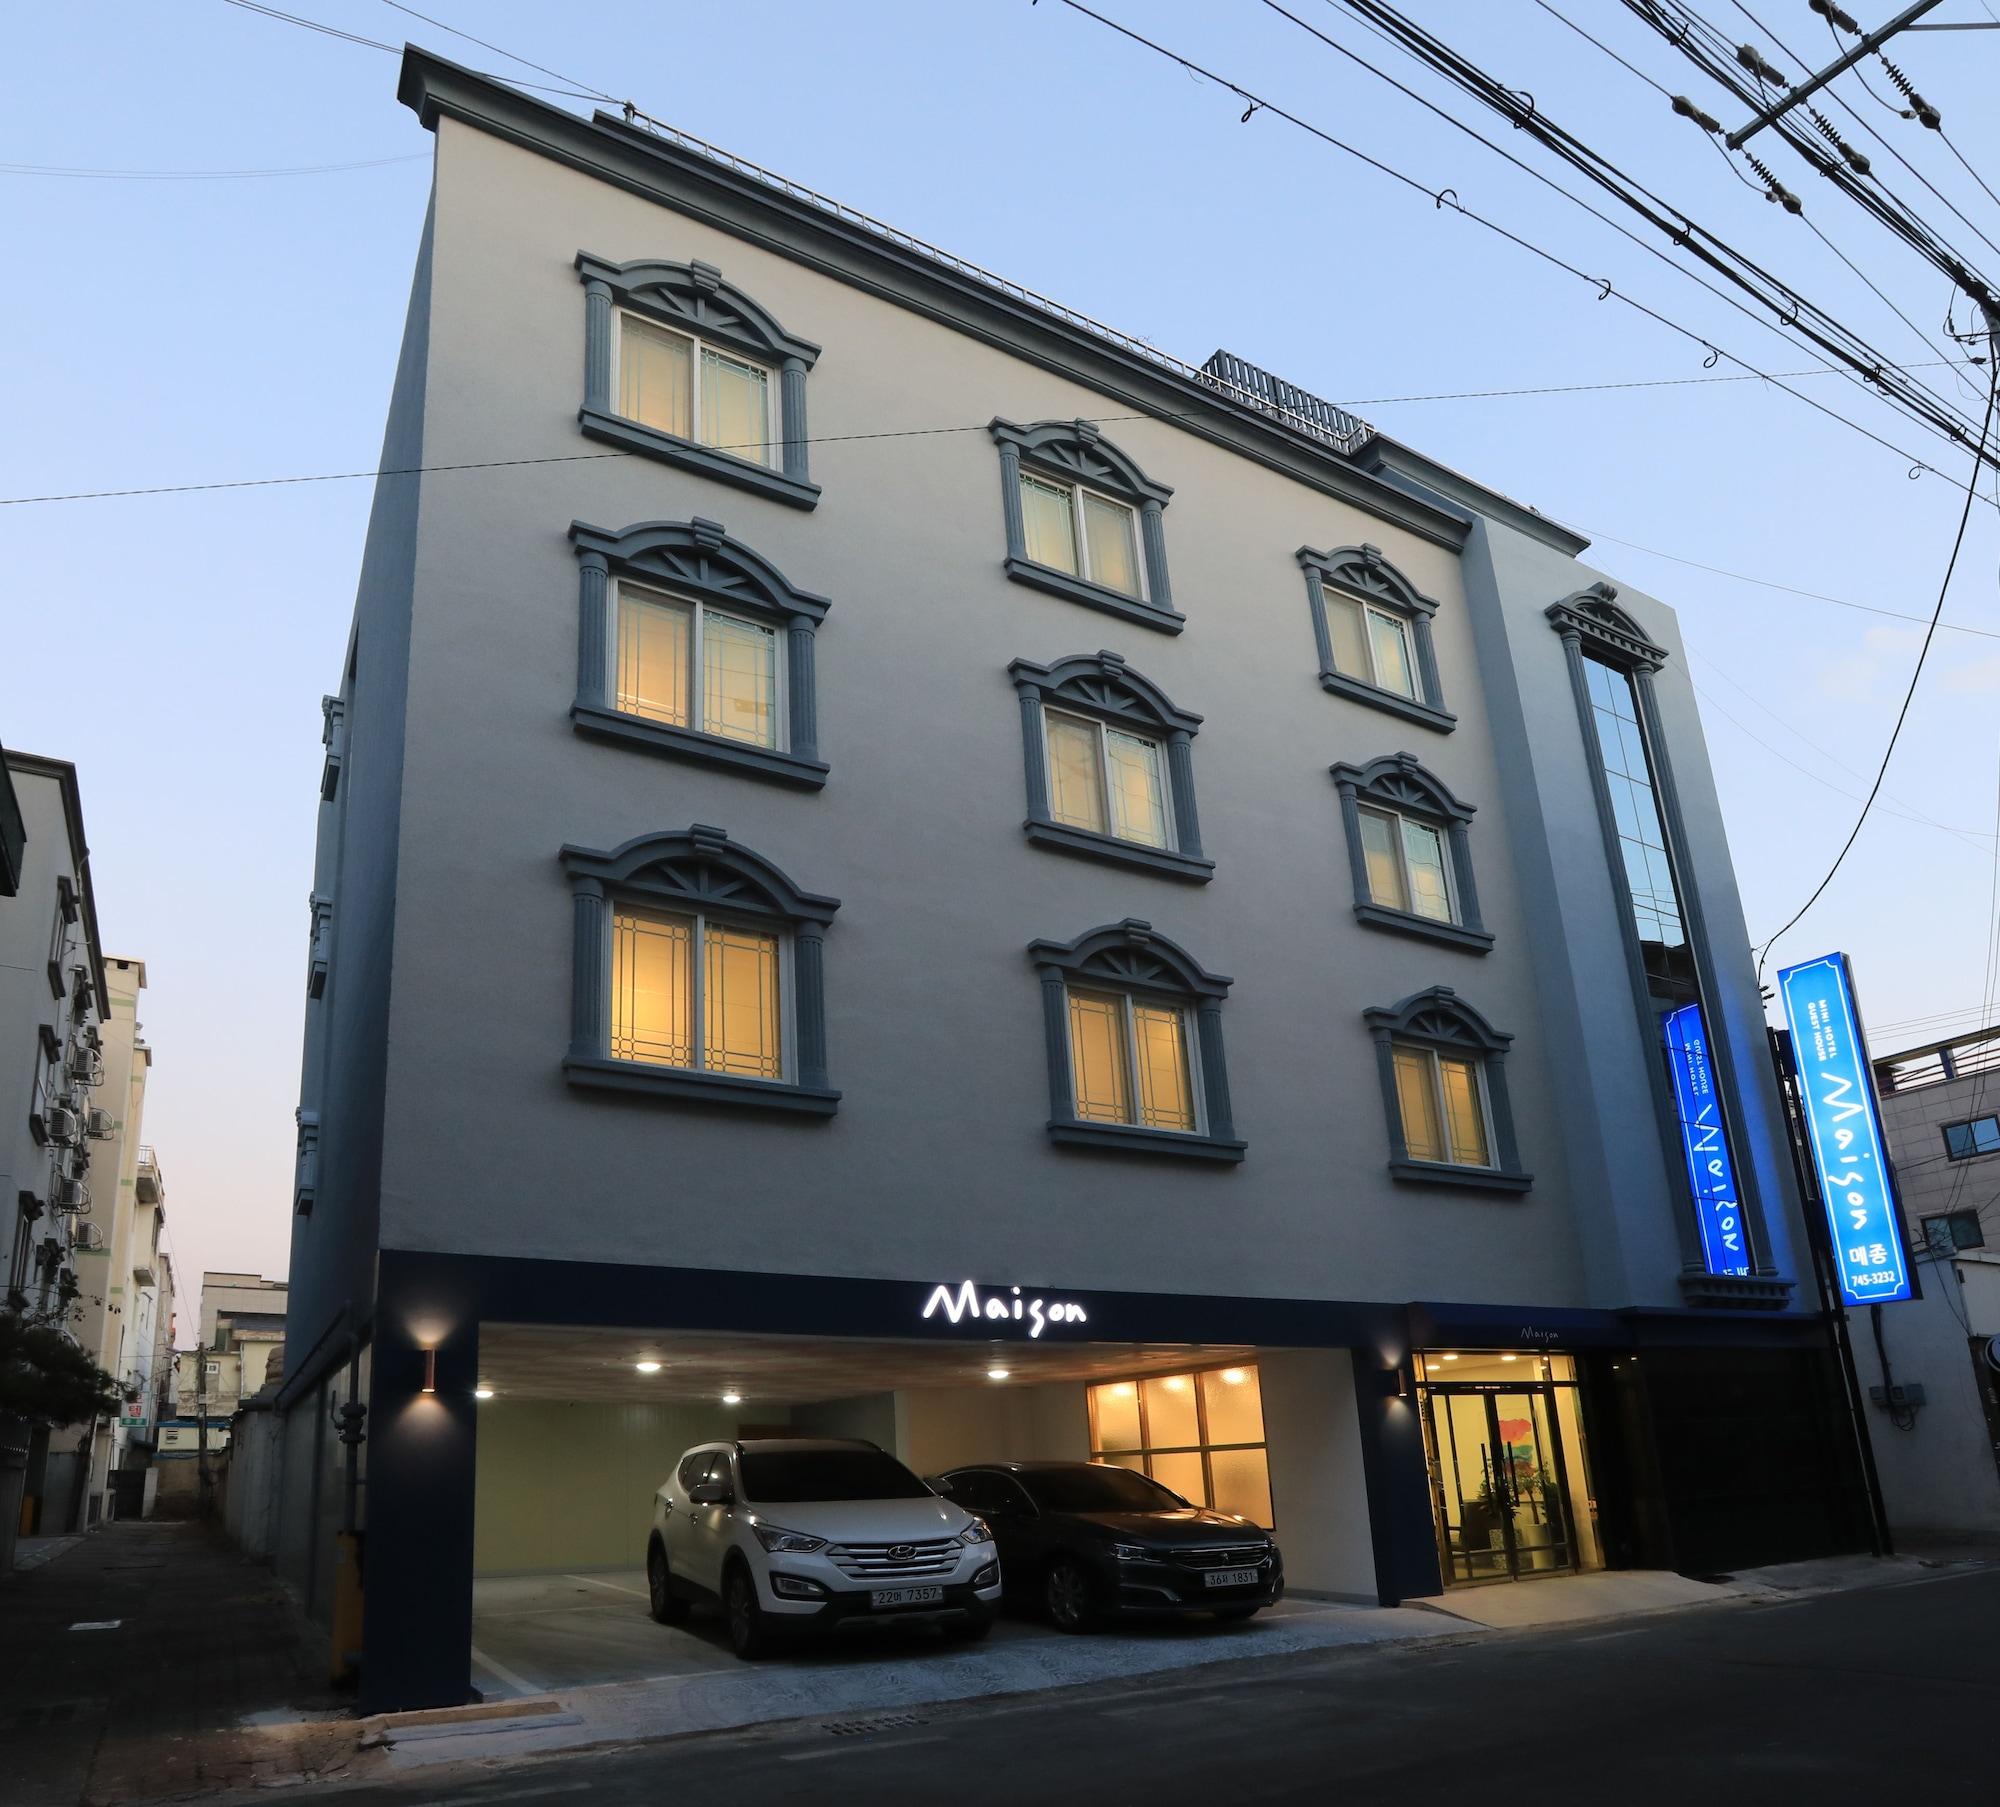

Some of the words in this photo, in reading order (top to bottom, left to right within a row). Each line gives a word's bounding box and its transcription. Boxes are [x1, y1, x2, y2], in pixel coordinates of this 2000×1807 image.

[1807, 1001, 1821, 1030] GUEST
[1814, 1031, 1827, 1062] HOUSE
[1818, 999, 1830, 1023] MINI
[1824, 1026, 1837, 1059] HOTEL
[1820, 1072, 1870, 1230] Maison
[1848, 1243, 1888, 1266] 메종
[1851, 1270, 1896, 1287] 745-3232
[922, 1279, 1088, 1339] Maison
[1520, 1325, 1559, 1344] Maison
[1232, 1572, 1254, 1583] 1831
[906, 1587, 938, 1601] 7357
